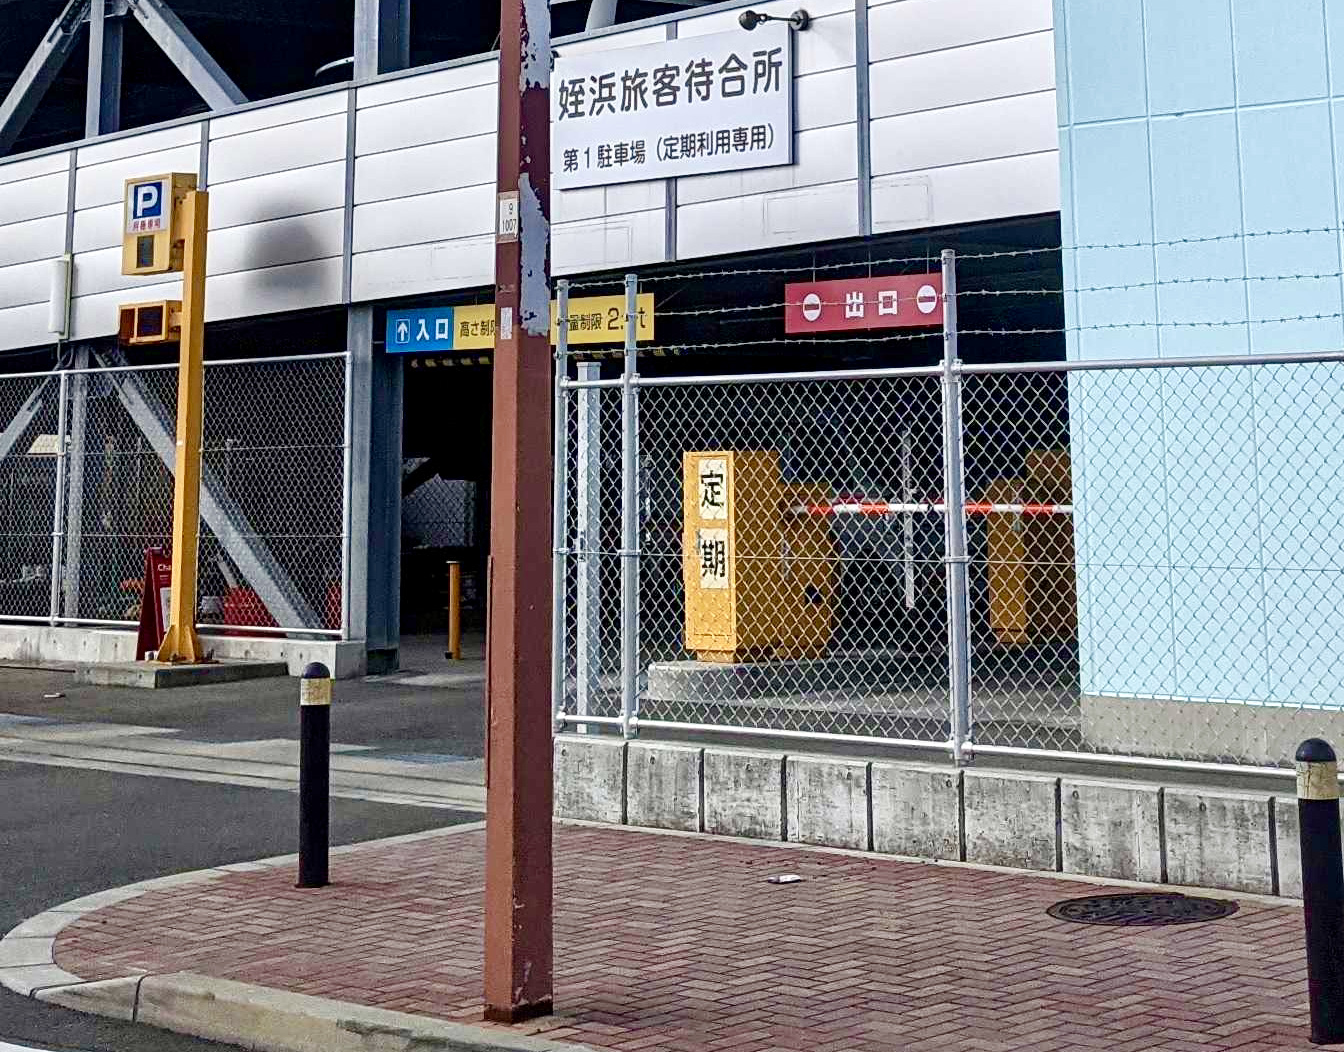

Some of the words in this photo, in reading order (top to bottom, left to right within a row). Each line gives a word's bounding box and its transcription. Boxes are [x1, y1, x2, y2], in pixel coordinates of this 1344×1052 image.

[558, 47, 783, 121] 姪浜旅客待合所
[137, 185, 158, 217] P
[560, 312, 602, 331] 量制限
[607, 306, 646, 331] 2.t
[845, 291, 898, 319] 出口
[416, 318, 449, 341] 入口
[700, 470, 726, 578] 定期
